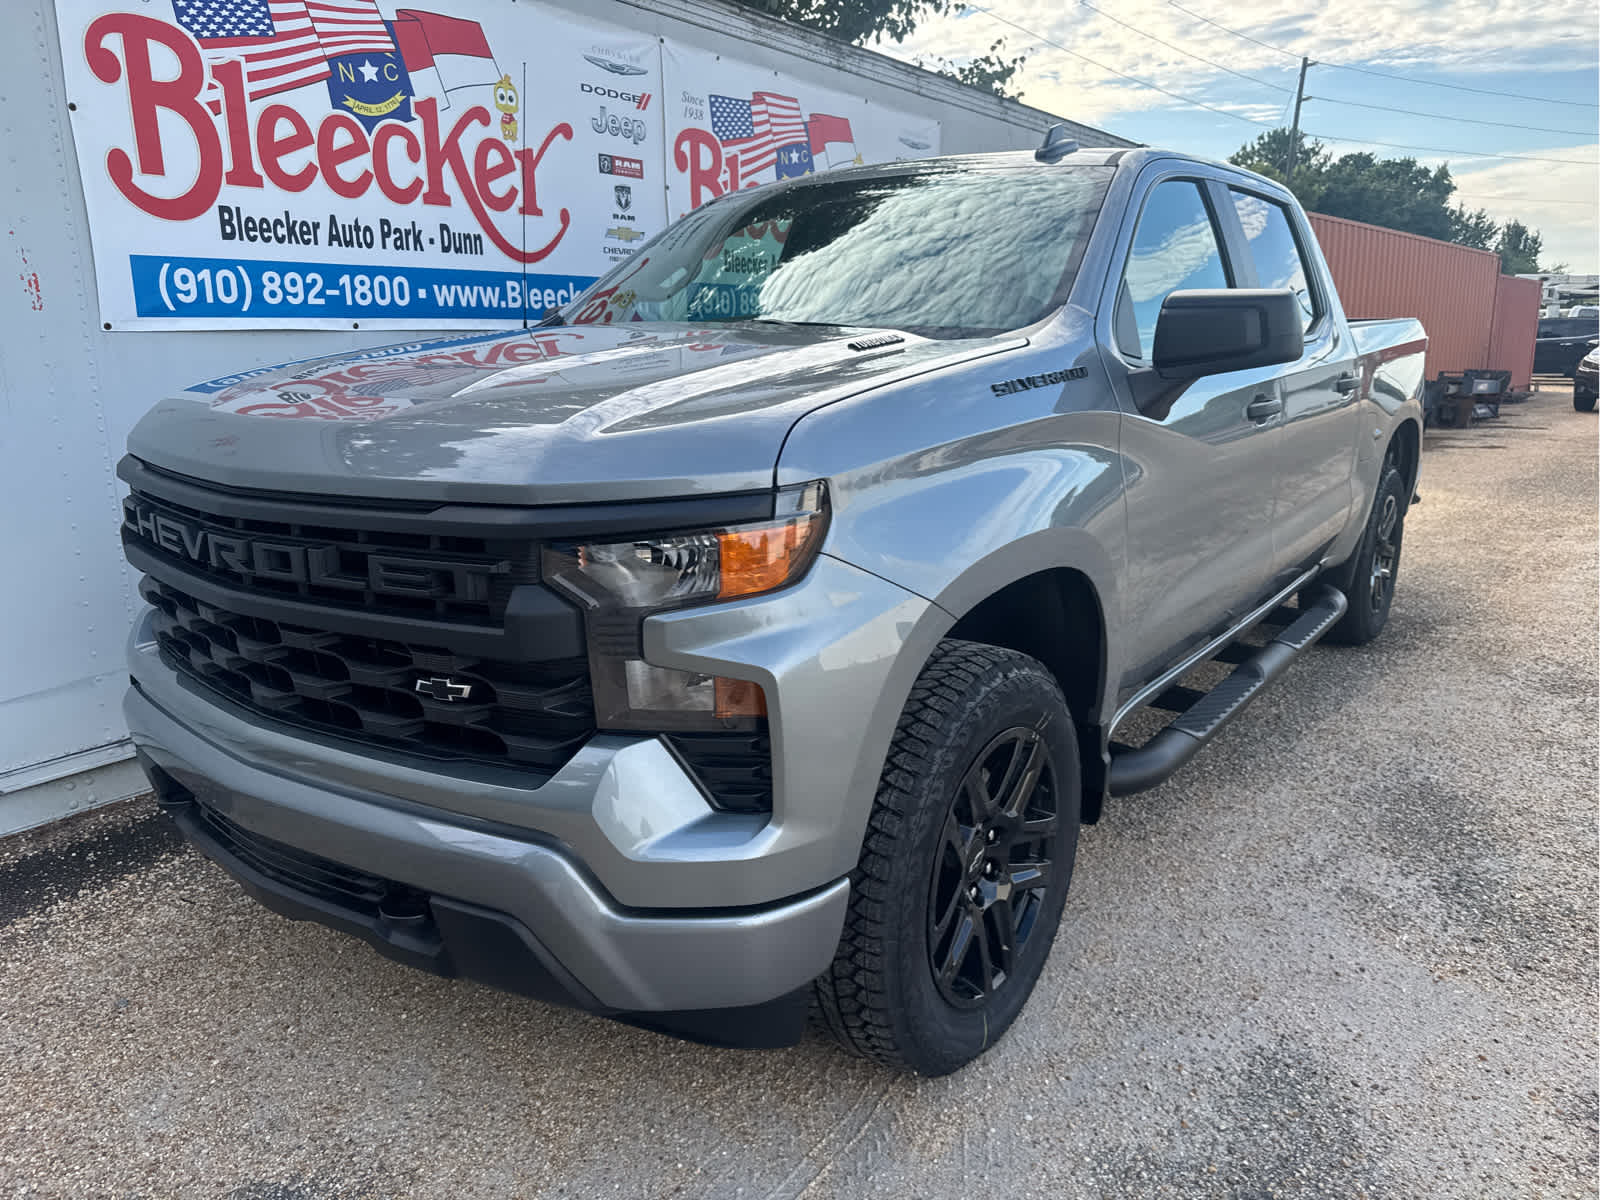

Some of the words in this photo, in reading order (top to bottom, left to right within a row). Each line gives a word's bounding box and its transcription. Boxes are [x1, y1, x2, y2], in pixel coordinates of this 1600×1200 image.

[338, 62, 356, 83] N
[384, 63, 399, 82] C
[580, 83, 643, 105] DODGE
[681, 90, 705, 106] Since
[591, 104, 647, 145] Jeep
[683, 106, 705, 121] 1938
[83, 12, 574, 264] Bleecker
[614, 159, 641, 170] RAM
[612, 213, 636, 222] RAM
[218, 205, 320, 246] Bleecker
[327, 214, 375, 250] Auto
[379, 218, 425, 252] Park
[439, 223, 484, 255] Dunn
[158, 262, 252, 312] (910)
[262, 270, 410, 308] 892-1800
[122, 502, 512, 602] CHEVROLET
